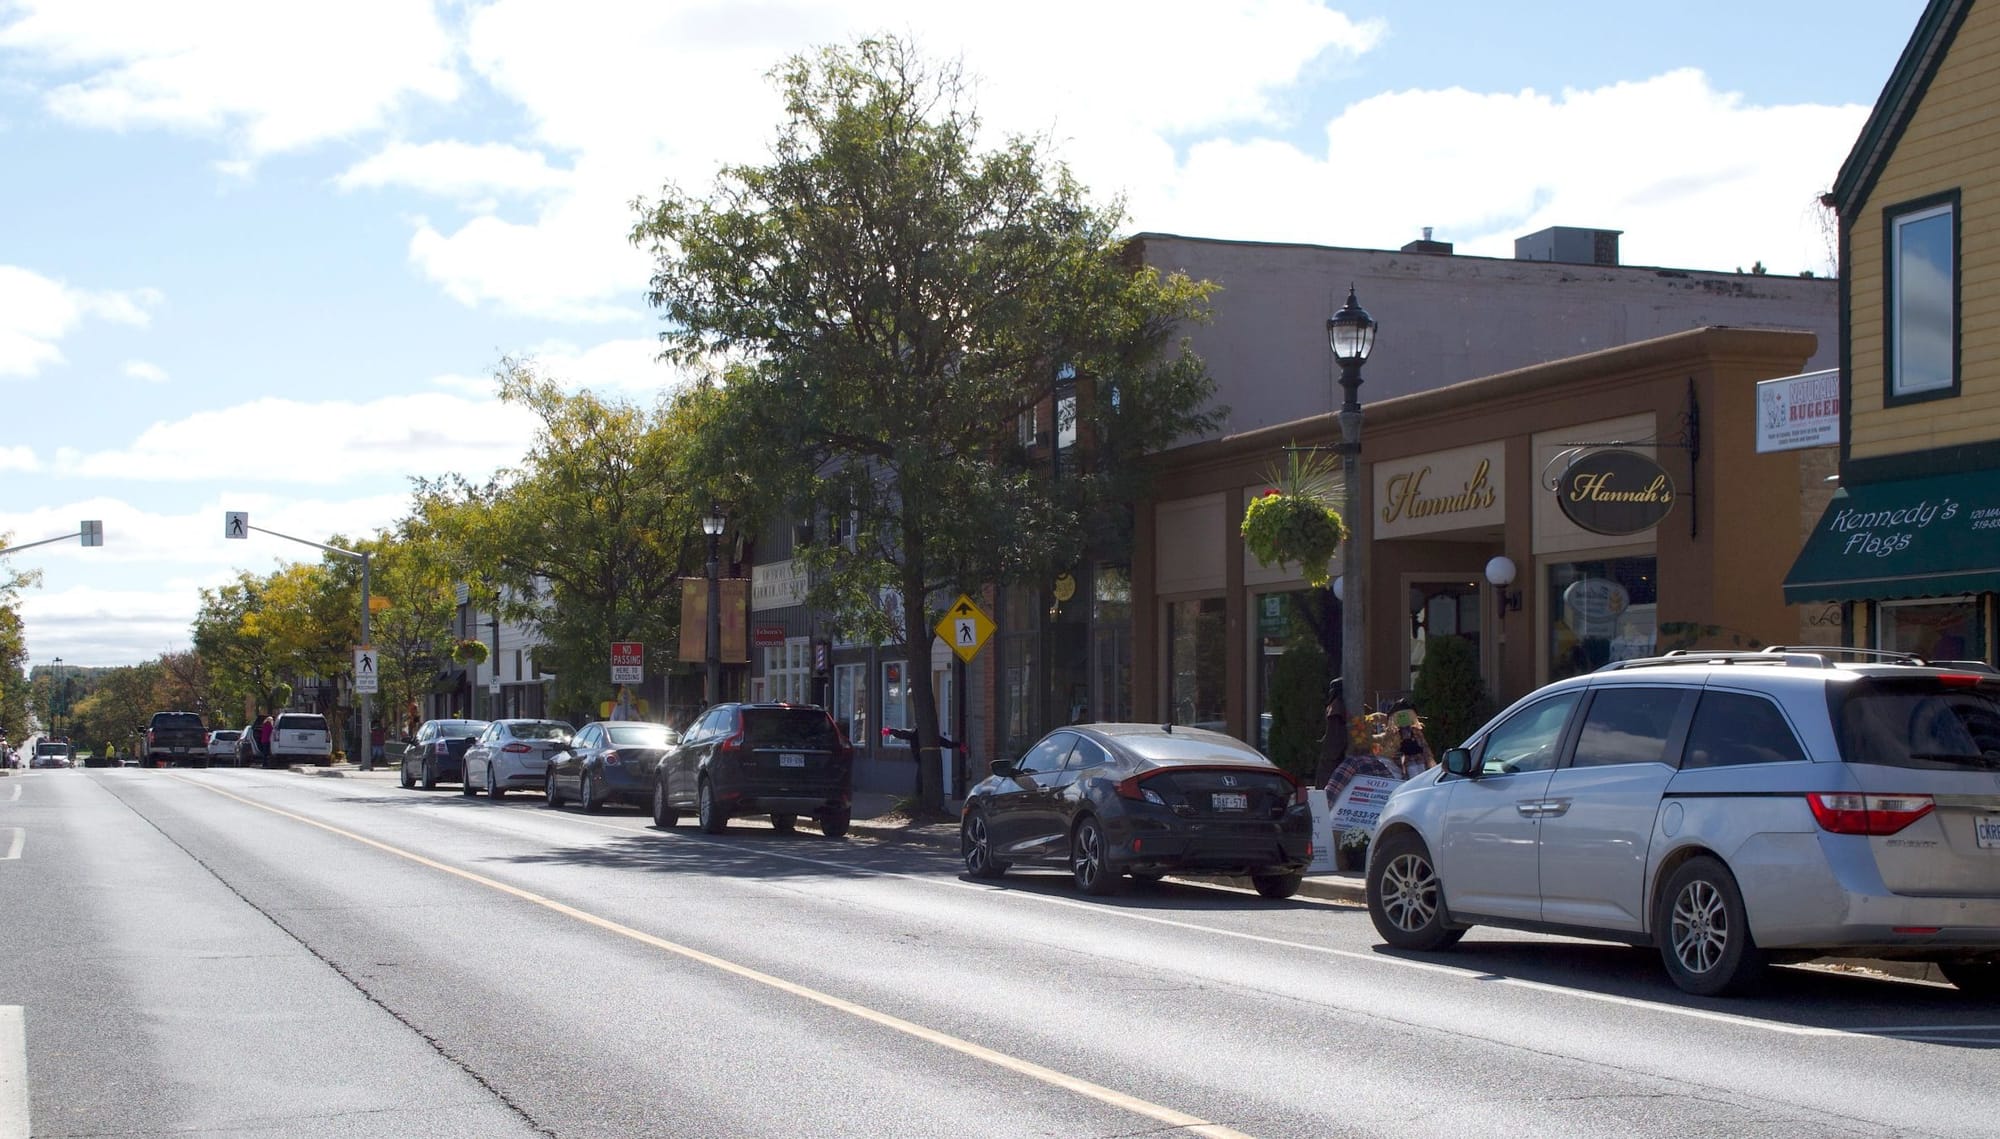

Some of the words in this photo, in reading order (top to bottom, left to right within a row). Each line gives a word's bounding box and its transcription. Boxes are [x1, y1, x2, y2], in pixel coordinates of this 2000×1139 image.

[1789, 399, 1839, 421] RUGGED
[1382, 458, 1496, 523] Hannah's
[1570, 472, 1672, 502] Hannah's
[1830, 498, 1959, 532] Kennedy's
[1843, 531, 1913, 557] Flags
[613, 655, 641, 665] PASSING
[622, 645, 632, 655] NO
[1367, 779, 1389, 788] SOLD
